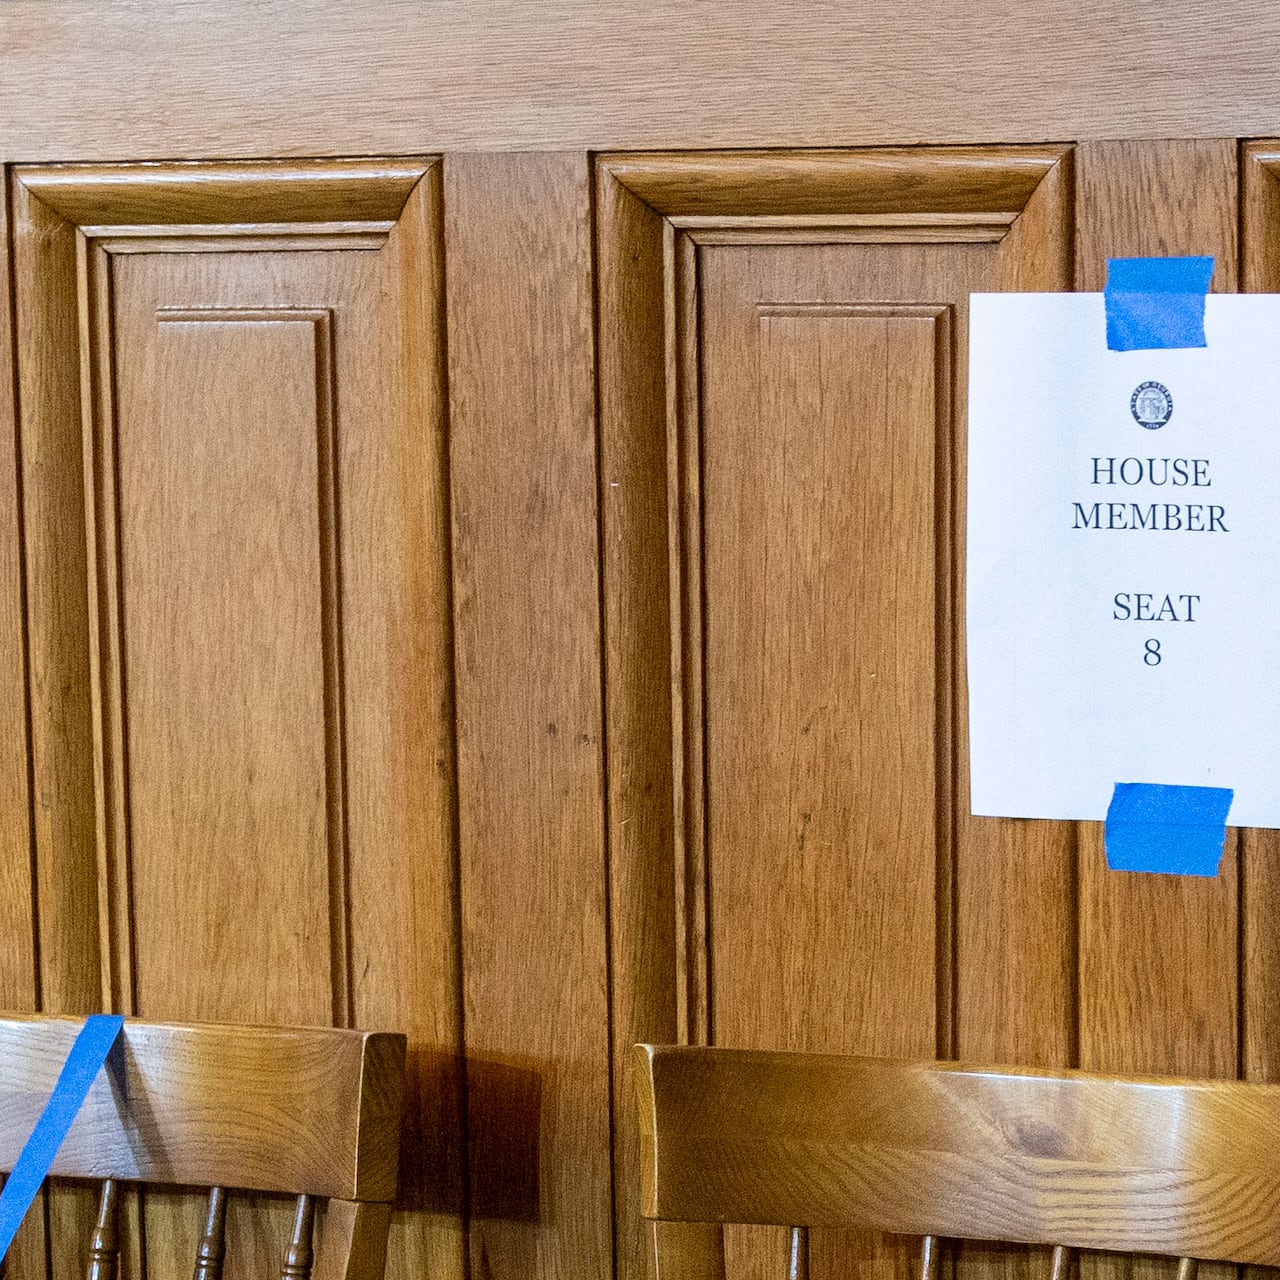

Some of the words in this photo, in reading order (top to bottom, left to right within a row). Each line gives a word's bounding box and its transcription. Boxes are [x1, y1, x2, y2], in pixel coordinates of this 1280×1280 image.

[1091, 457, 1212, 487] HOUSE
[1072, 502, 1230, 533] MEMBER
[1113, 592, 1200, 623] SEAT
[1143, 638, 1162, 667] 8
